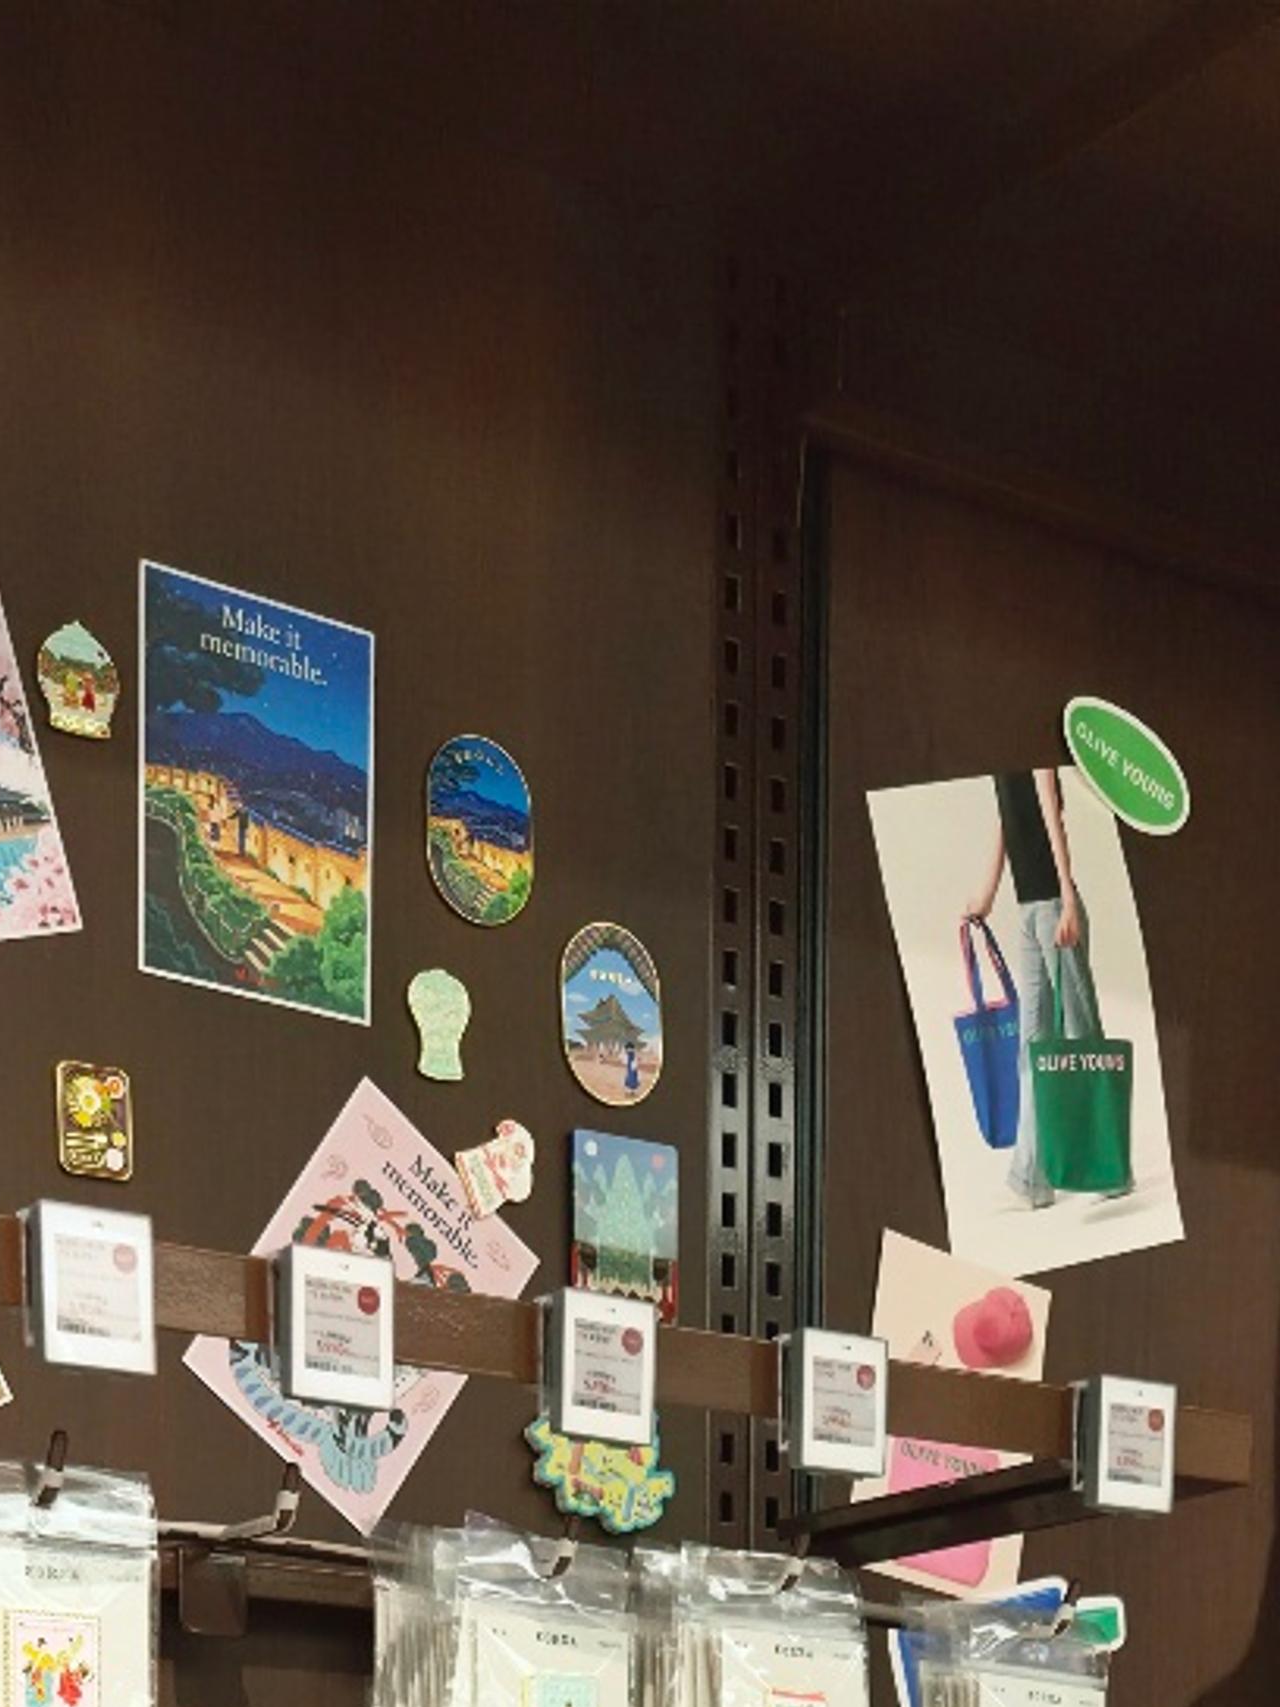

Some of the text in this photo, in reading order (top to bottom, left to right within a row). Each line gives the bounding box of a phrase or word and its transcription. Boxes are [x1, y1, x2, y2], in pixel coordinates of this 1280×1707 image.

[200, 629, 328, 685] memorable.
[221, 604, 303, 651] Make it
[1075, 720, 1176, 811] OLIVE YOUNG
[1036, 1053, 1125, 1073] OLIVE YOUNG
[409, 1153, 456, 1215] Make
[381, 1159, 480, 1269] memorable.
